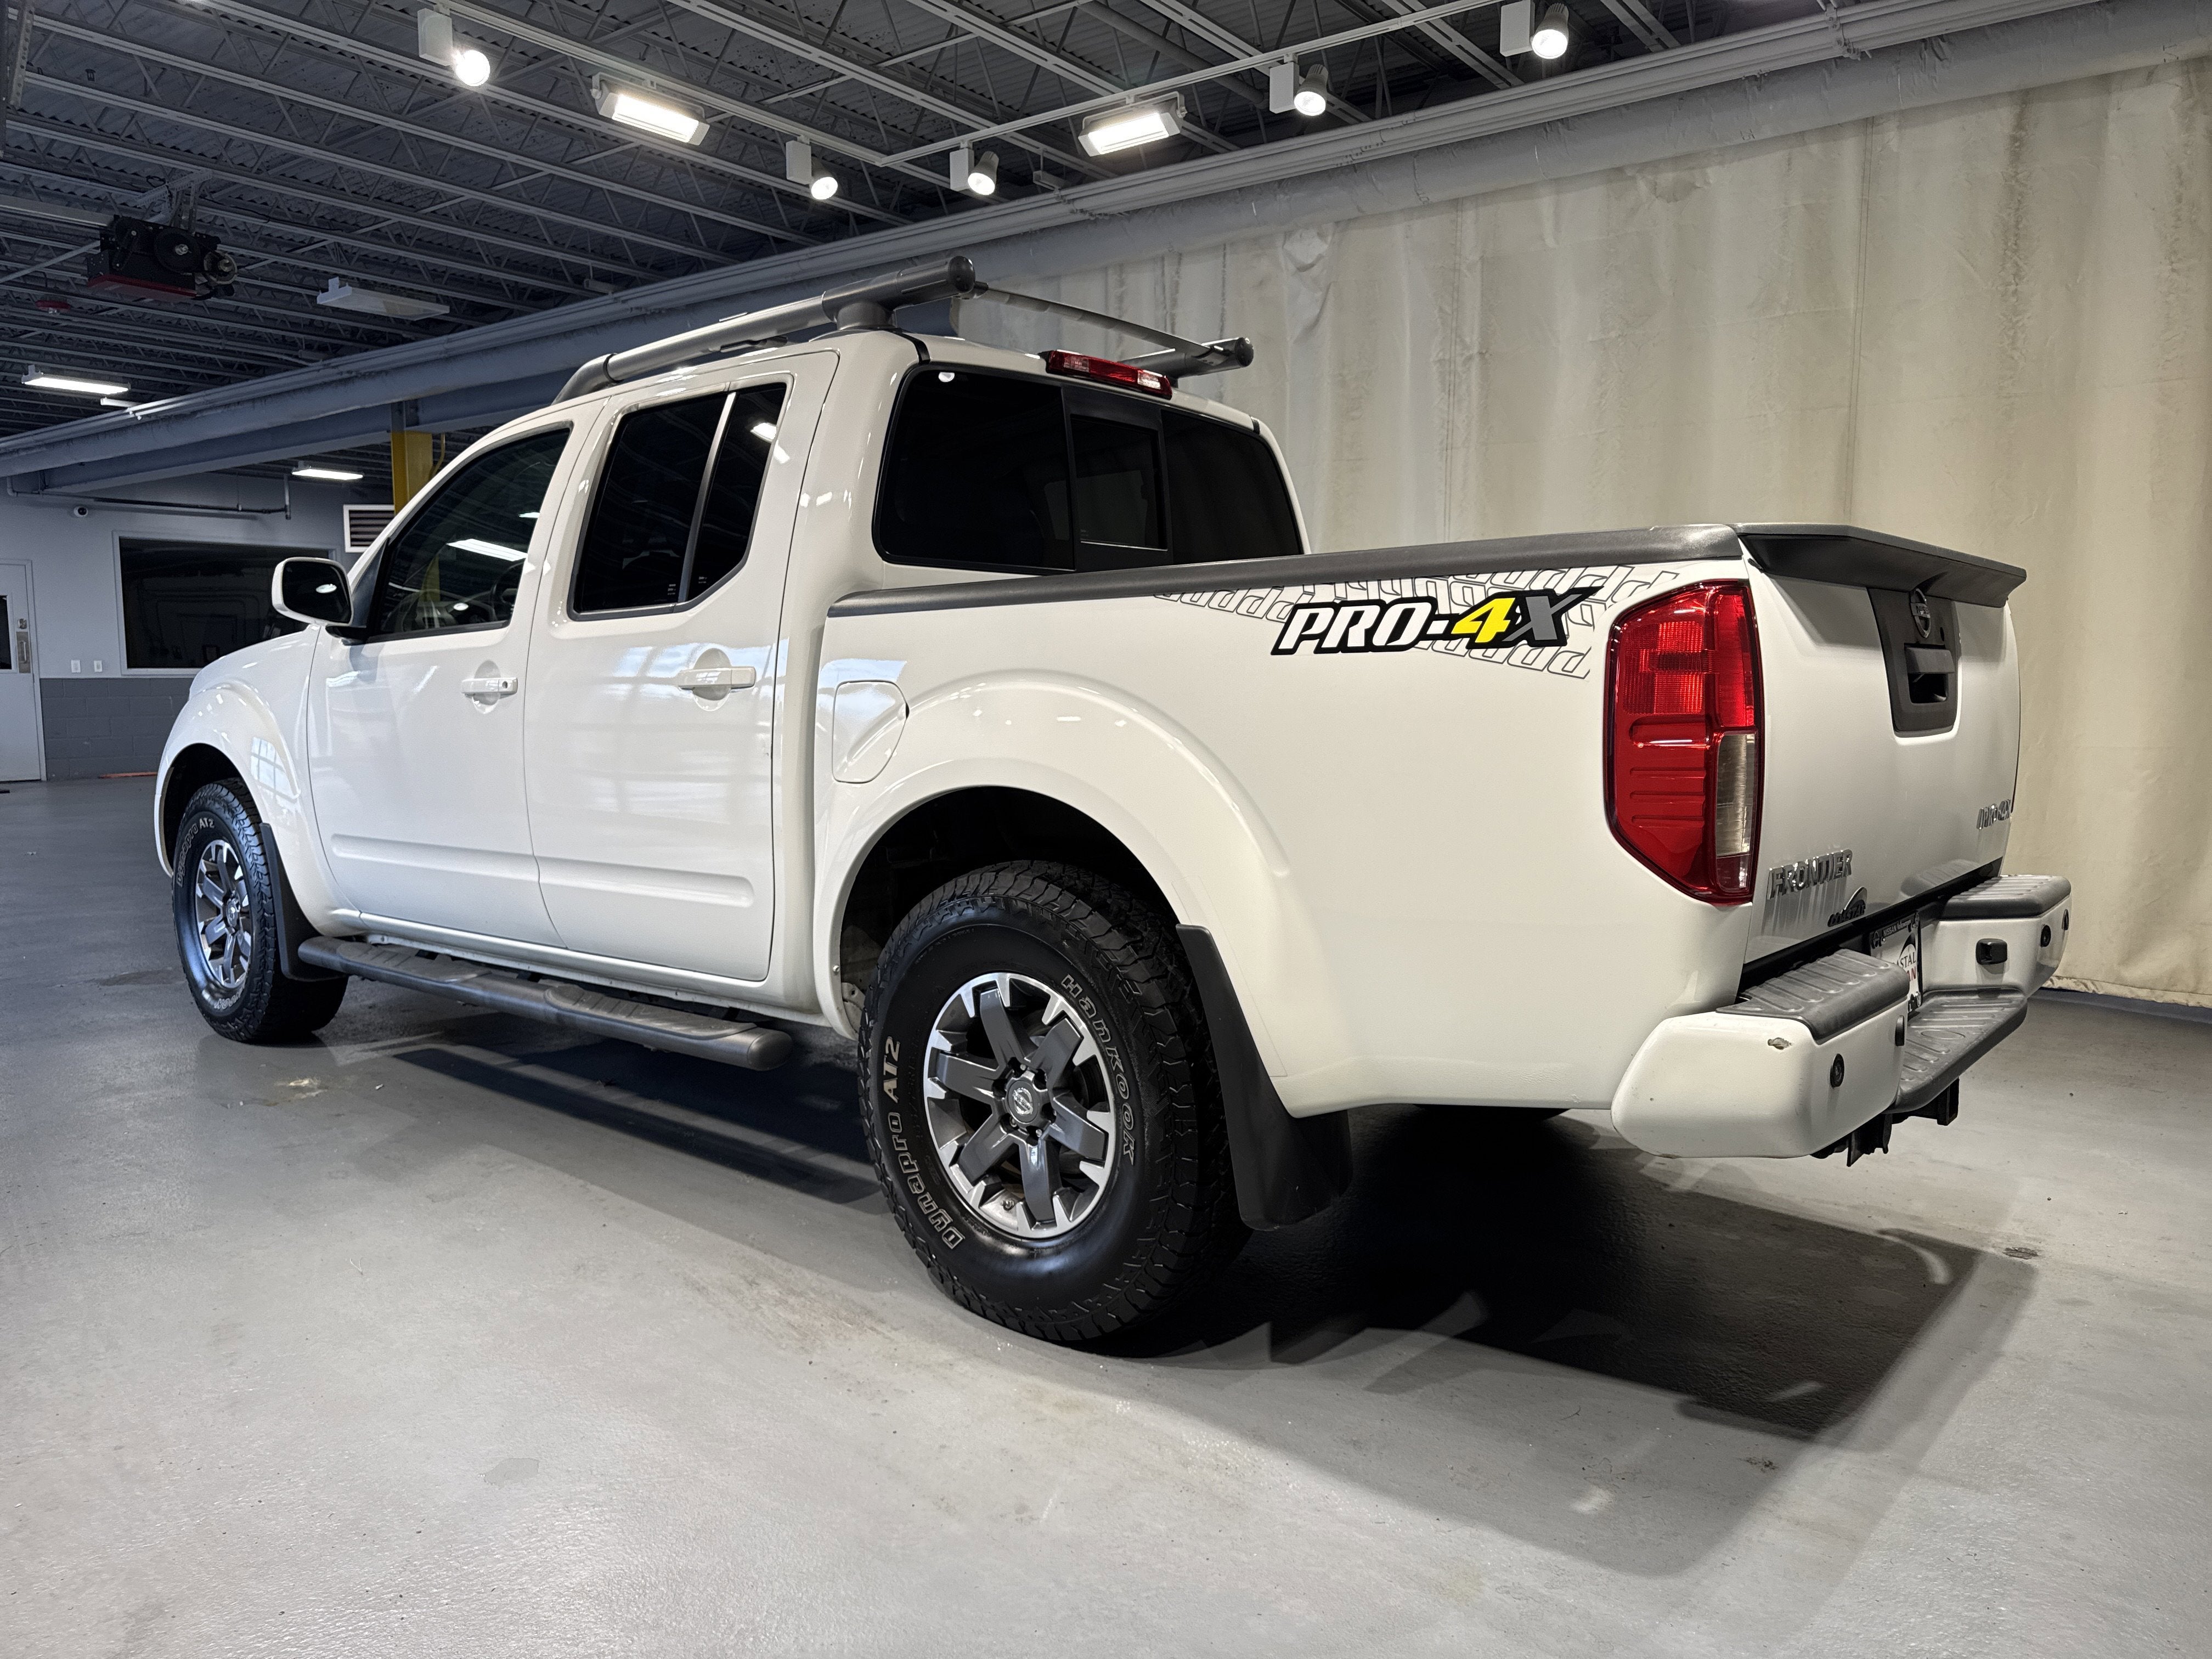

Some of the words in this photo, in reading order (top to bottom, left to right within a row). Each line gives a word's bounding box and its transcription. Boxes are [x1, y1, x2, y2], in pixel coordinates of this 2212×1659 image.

[1272, 587, 1601, 655] PRO-4X
[199, 817, 215, 830] AT2
[1766, 849, 1853, 900] FRONTIER
[1898, 951, 1916, 969] STAL
[883, 1036, 901, 1104] AT2
[888, 1111, 966, 1250] Dynapro
